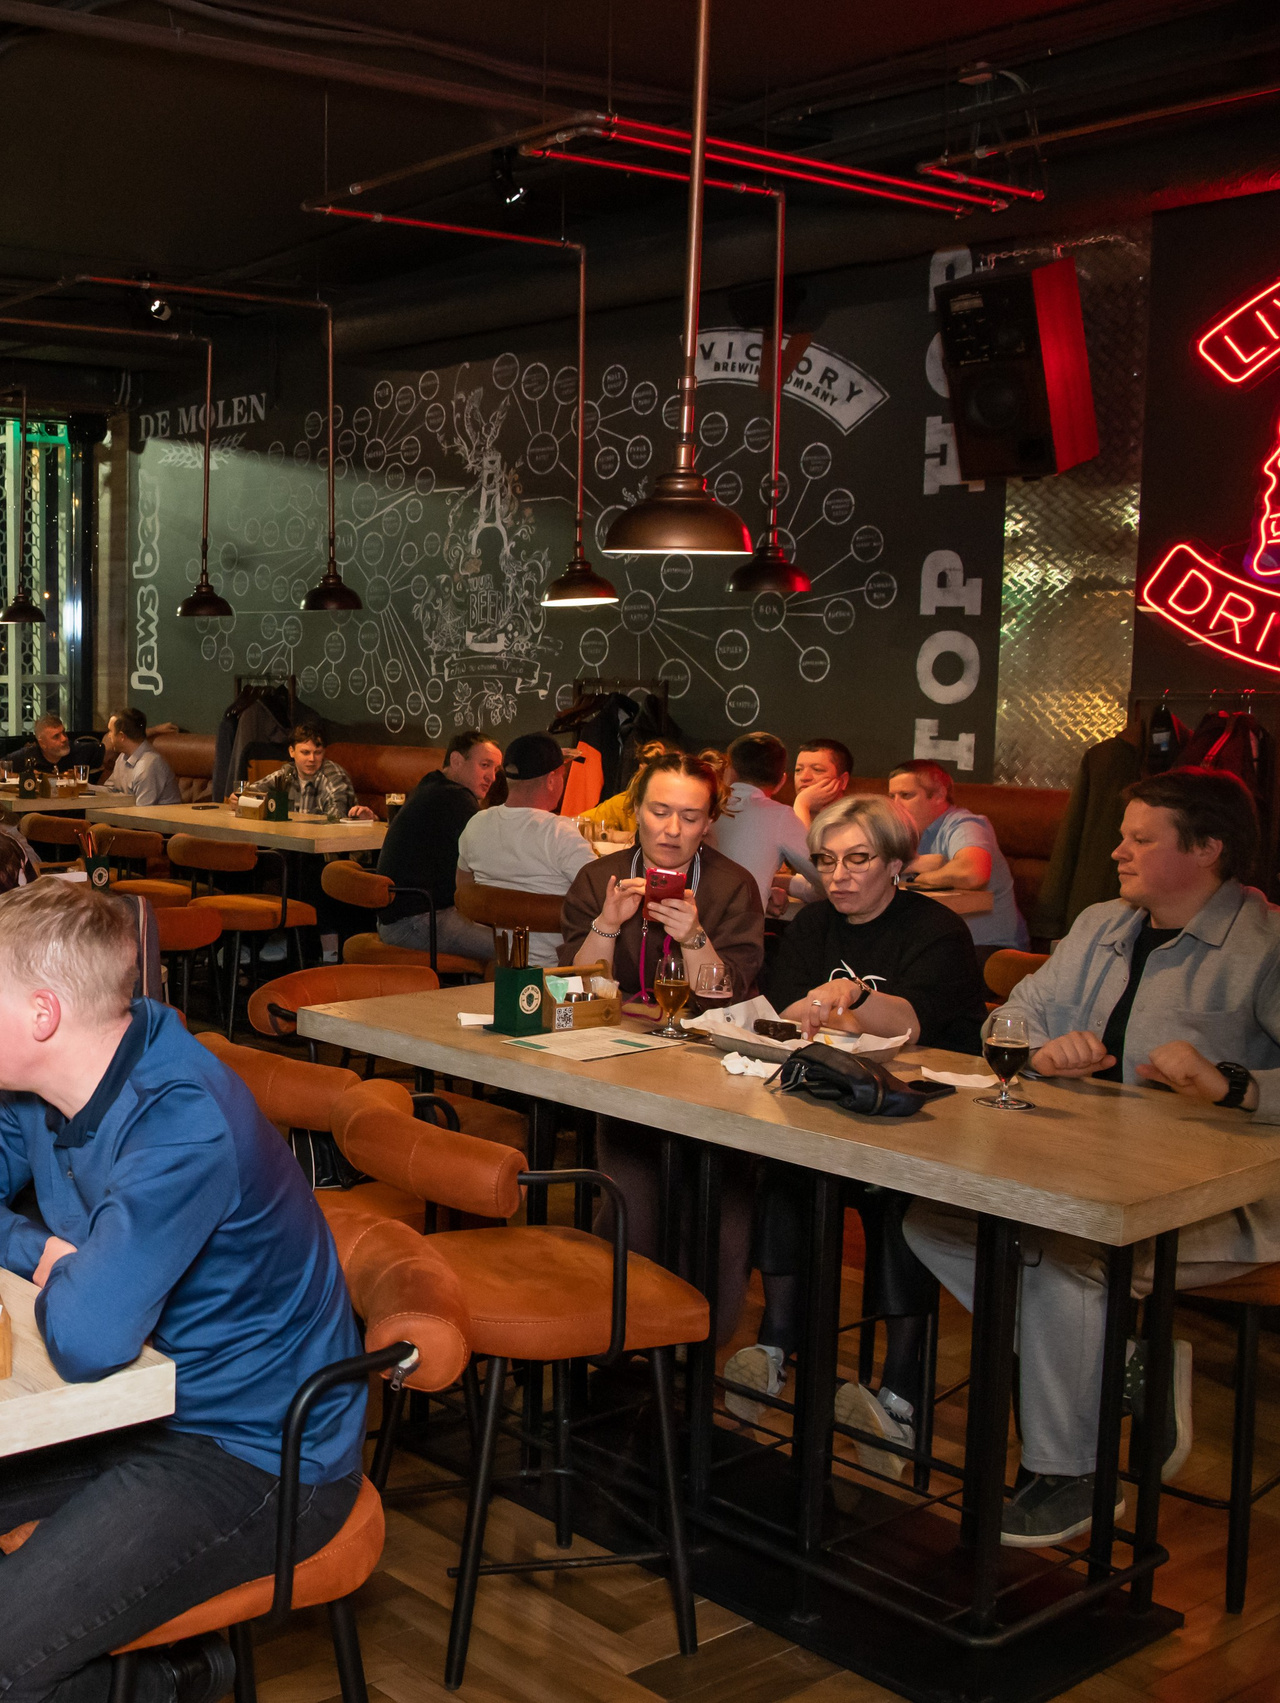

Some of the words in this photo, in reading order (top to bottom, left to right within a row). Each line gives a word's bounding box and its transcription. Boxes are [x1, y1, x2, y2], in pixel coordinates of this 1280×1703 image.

[699, 341, 864, 404] VICORY
[922, 244, 986, 495] HP
[1223, 298, 1280, 363] LI
[139, 410, 170, 442] DE
[177, 393, 267, 435] MOLEN
[785, 374, 839, 407] OMPANY
[132, 468, 161, 580] beer
[131, 584, 164, 696] Jaws
[1167, 568, 1280, 653] DRI
[914, 548, 983, 771] TOP
